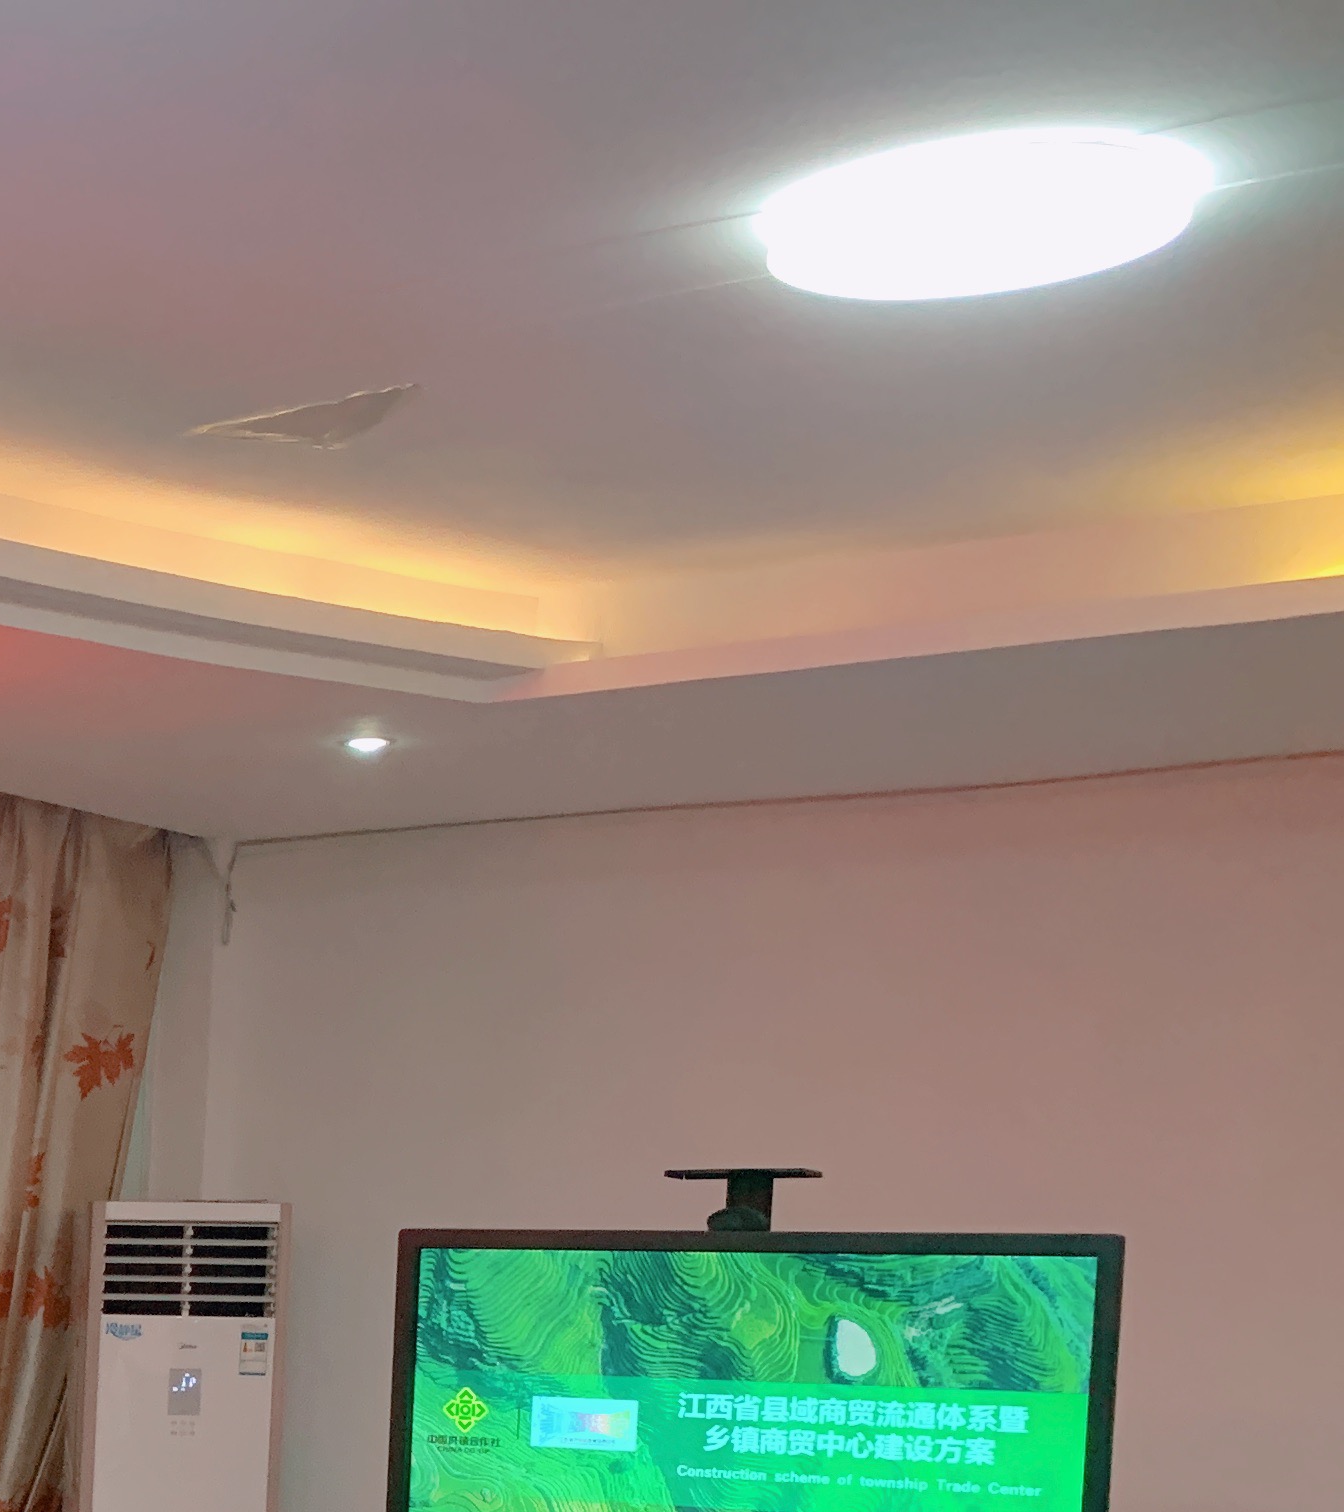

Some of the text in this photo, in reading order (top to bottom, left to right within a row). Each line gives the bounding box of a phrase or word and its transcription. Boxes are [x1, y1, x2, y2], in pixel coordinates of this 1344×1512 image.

[677, 1391, 1029, 1433] 江西省县域商贸流通体系暨
[702, 1425, 996, 1466] 乡镇商贸中心建设方案
[677, 1464, 1044, 1498] Construction scheme of township Trade Center
